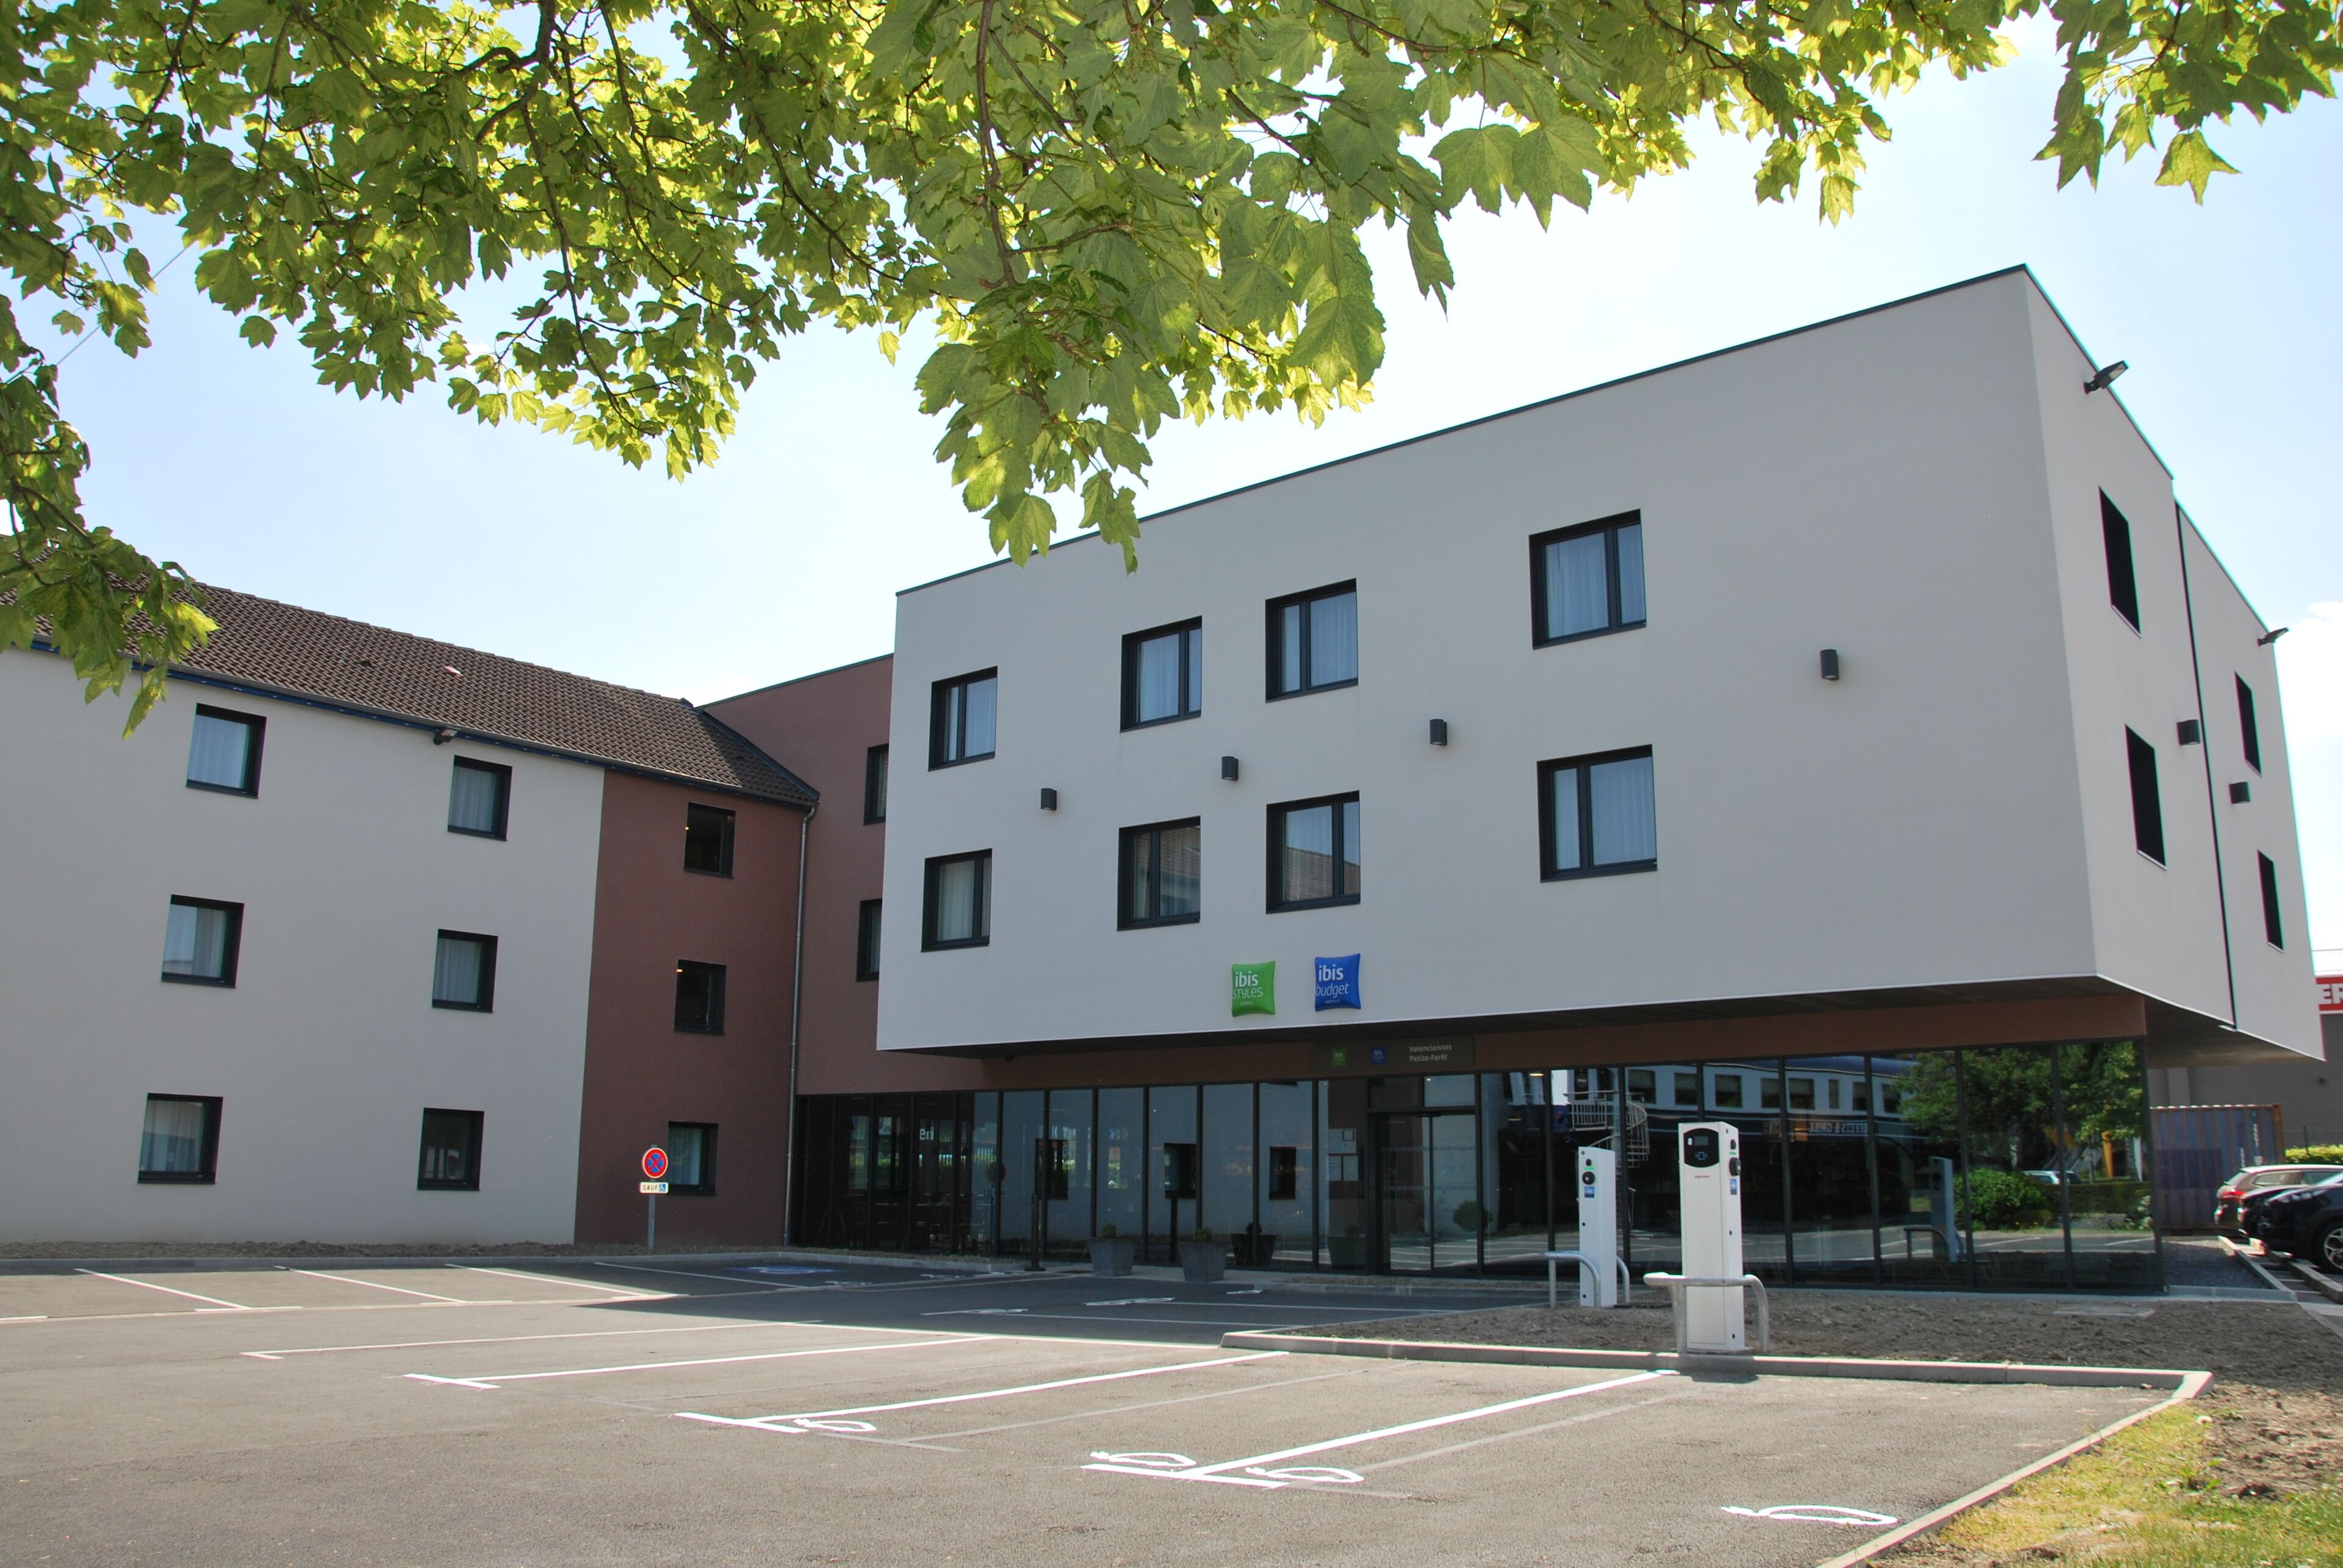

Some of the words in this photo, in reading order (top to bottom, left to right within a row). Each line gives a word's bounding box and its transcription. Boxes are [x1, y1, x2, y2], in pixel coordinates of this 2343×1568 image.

[1236, 971, 1258, 987] ibis
[1319, 964, 1344, 982] ibis
[1316, 983, 1350, 998] budget
[1409, 1044, 1452, 1052] Valenciennes
[1409, 1053, 1448, 1062] Petite-Forêt
